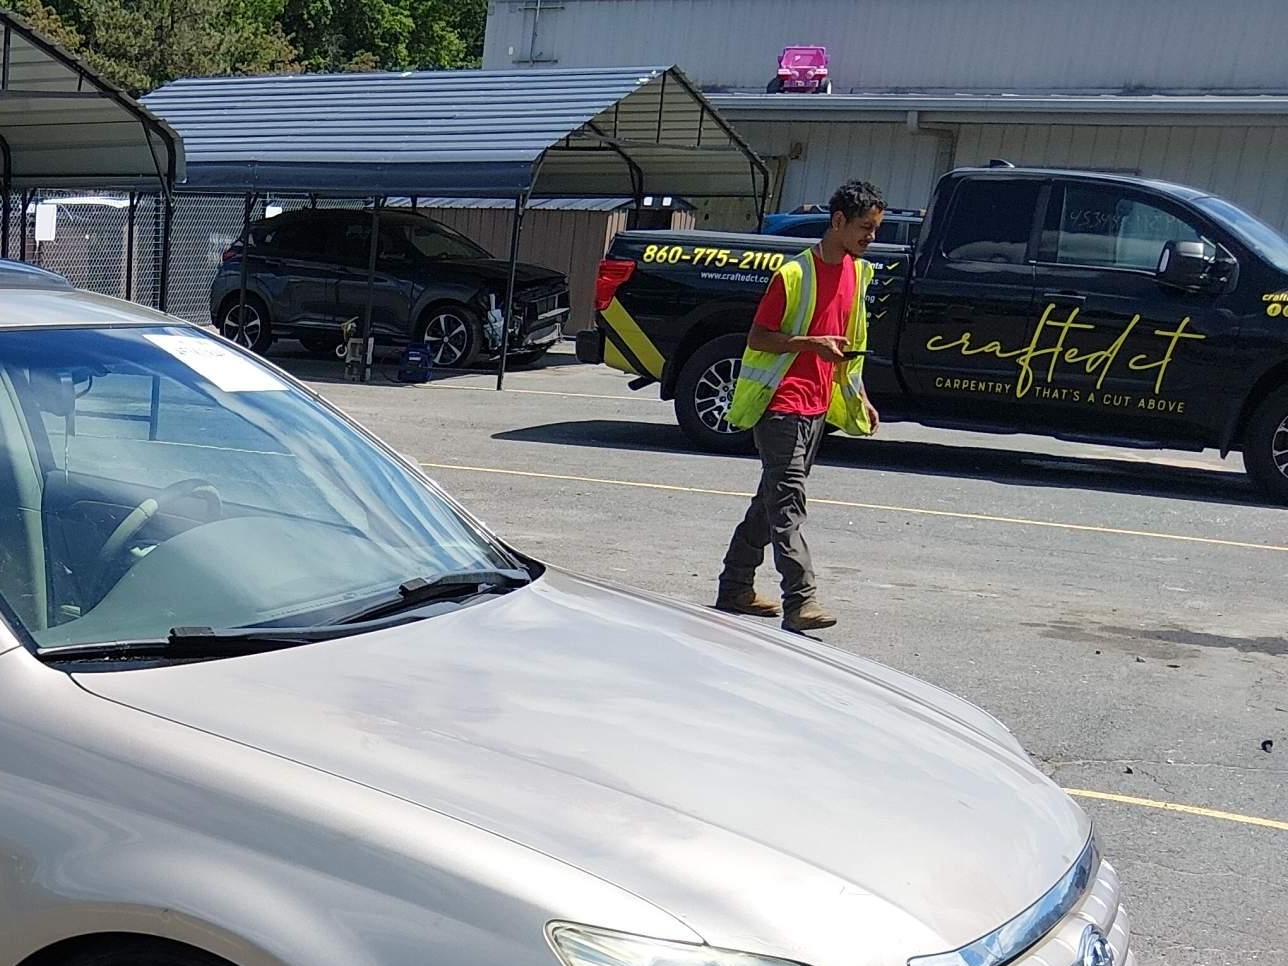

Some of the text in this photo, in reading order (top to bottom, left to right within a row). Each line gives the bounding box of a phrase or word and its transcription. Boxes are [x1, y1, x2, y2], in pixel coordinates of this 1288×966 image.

[642, 244, 785, 271] 860-775-2110
[700, 271, 769, 284] www.craftedct.co
[935, 377, 1185, 413] CARPENTRY THAT'S A CUT ABOVE
